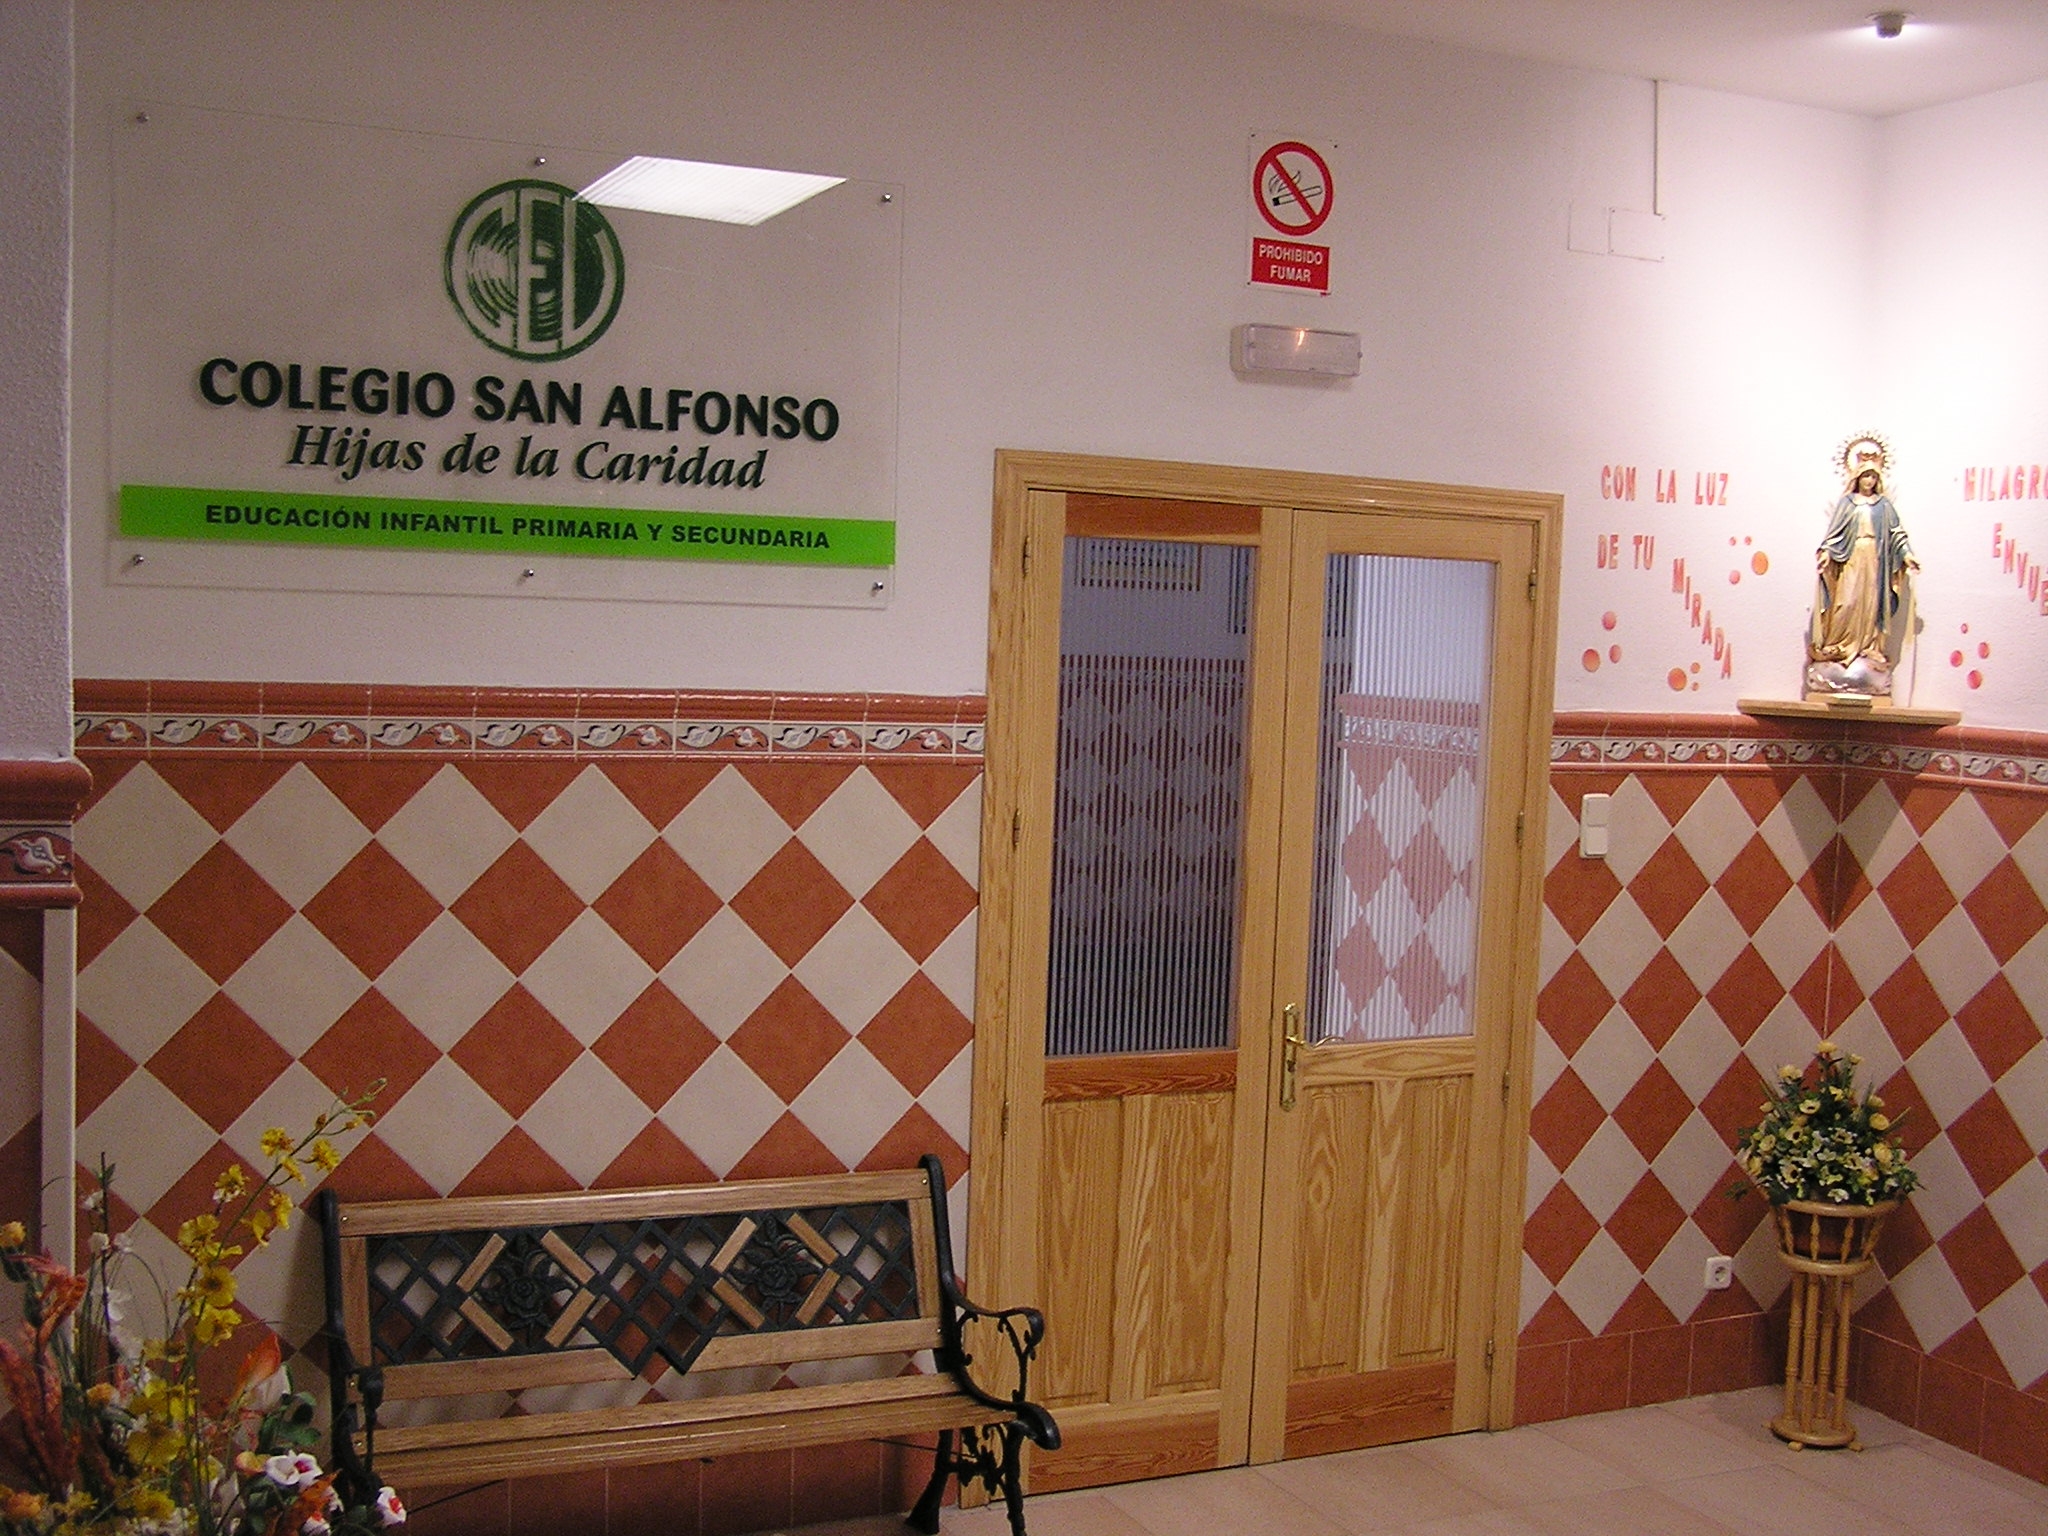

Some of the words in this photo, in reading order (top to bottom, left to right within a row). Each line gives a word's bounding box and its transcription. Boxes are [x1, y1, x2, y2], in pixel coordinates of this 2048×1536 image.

[1259, 244, 1323, 265] PROHIBIDO
[1270, 264, 1312, 282] FUMAR
[199, 357, 455, 418] COLEGIO
[474, 375, 582, 426] SAN
[600, 384, 840, 442] ALFONSO
[287, 424, 427, 481] Hijas
[442, 431, 501, 475] de
[514, 435, 560, 478] la
[575, 441, 769, 489] Caridad
[1601, 465, 1636, 501] CON
[1656, 469, 1677, 504] LA
[1695, 472, 1728, 506] LUZ
[206, 505, 370, 529] EDUCACIÓN
[381, 512, 503, 535] INFANTIL
[512, 518, 639, 541] PRIMARIA
[647, 523, 663, 541] Y
[671, 525, 831, 549] SECUNDARIA
[1597, 534, 1619, 569] DE
[1633, 535, 1655, 570] TU
[1672, 558, 1732, 680] MIRADA
